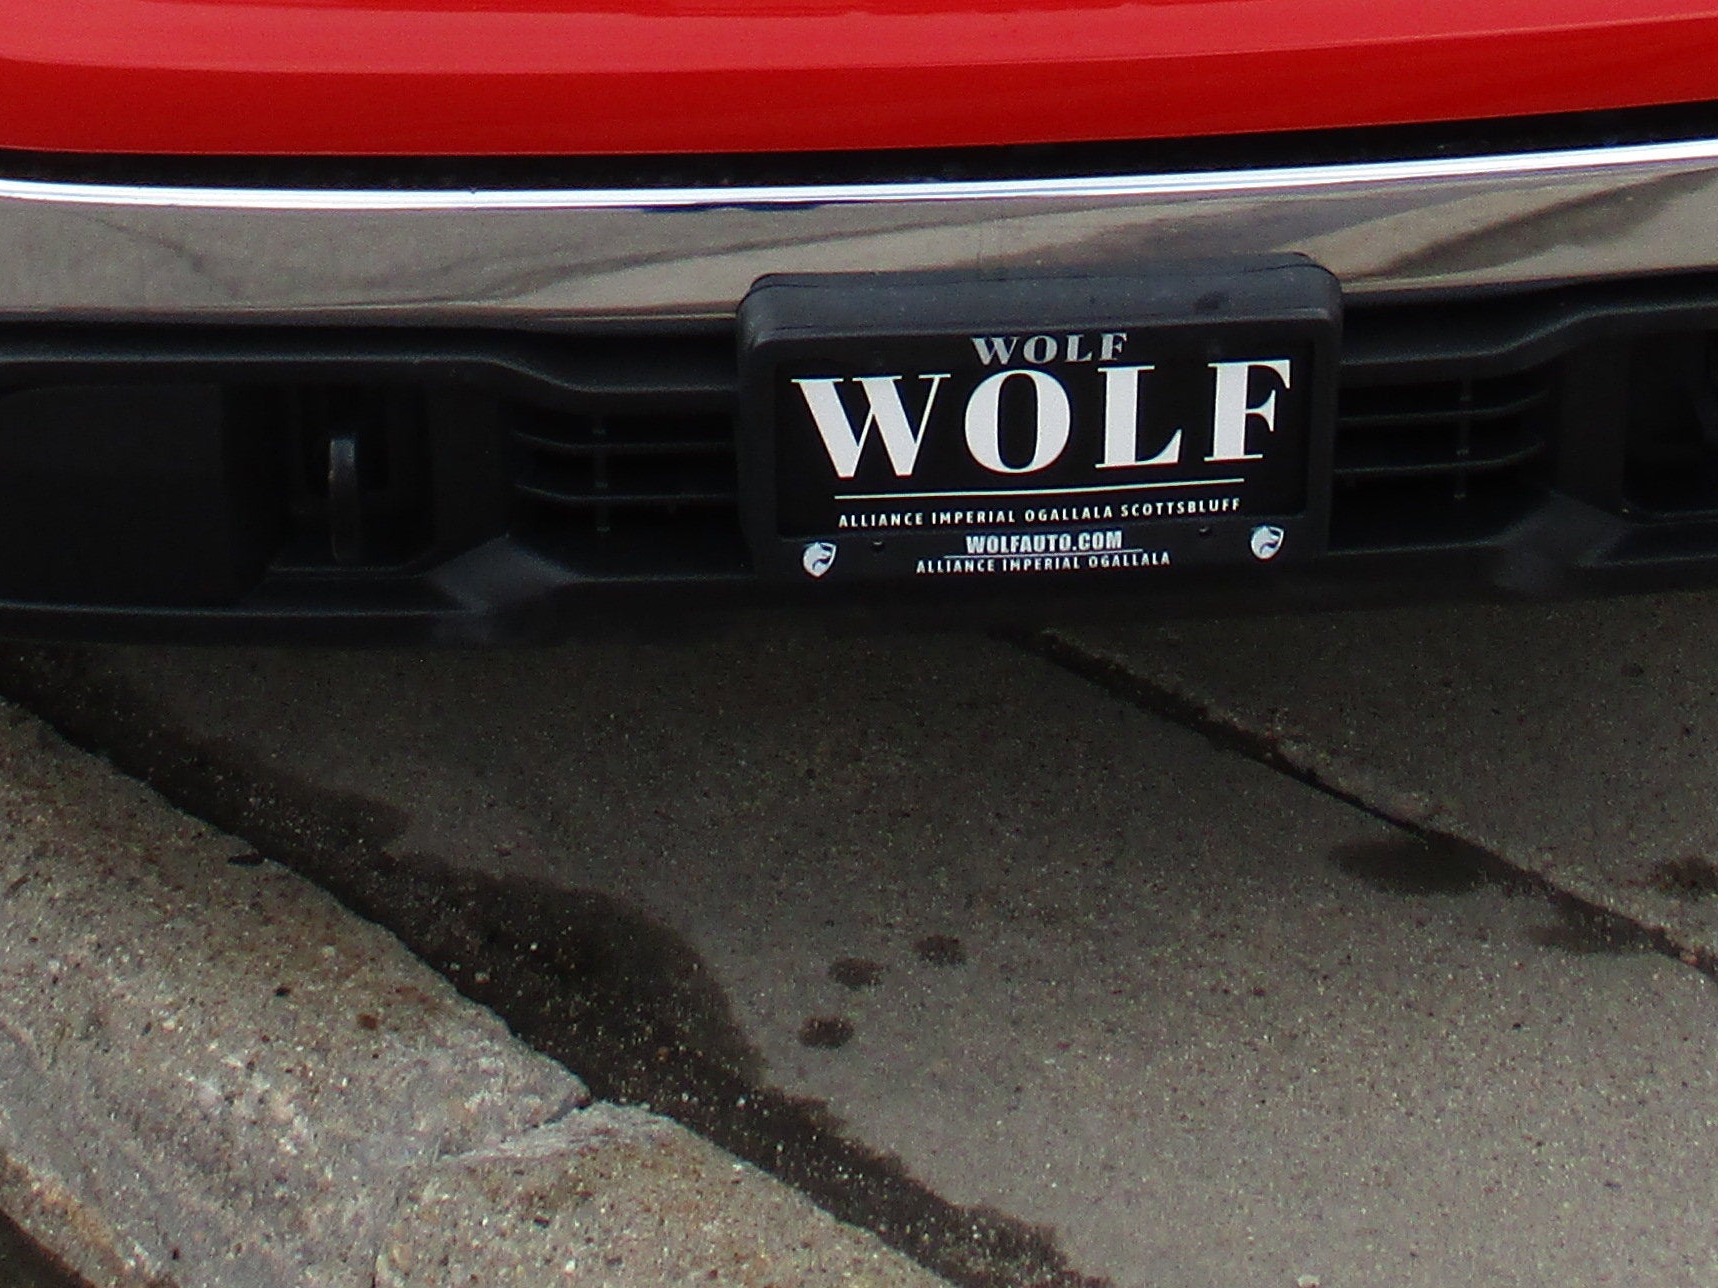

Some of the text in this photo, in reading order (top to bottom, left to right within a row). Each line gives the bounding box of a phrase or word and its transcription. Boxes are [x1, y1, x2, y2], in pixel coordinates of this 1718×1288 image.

[970, 331, 1128, 366] WOLF
[791, 359, 1291, 479] WOLF
[838, 497, 1241, 528] ALLIANCE IMPERIAL OGALLALA SCOTTSBLUFF
[965, 530, 1123, 555] WOLFAUTO.COM
[916, 551, 1171, 574] ALLIANCE IMPERIAL OGALLALA
